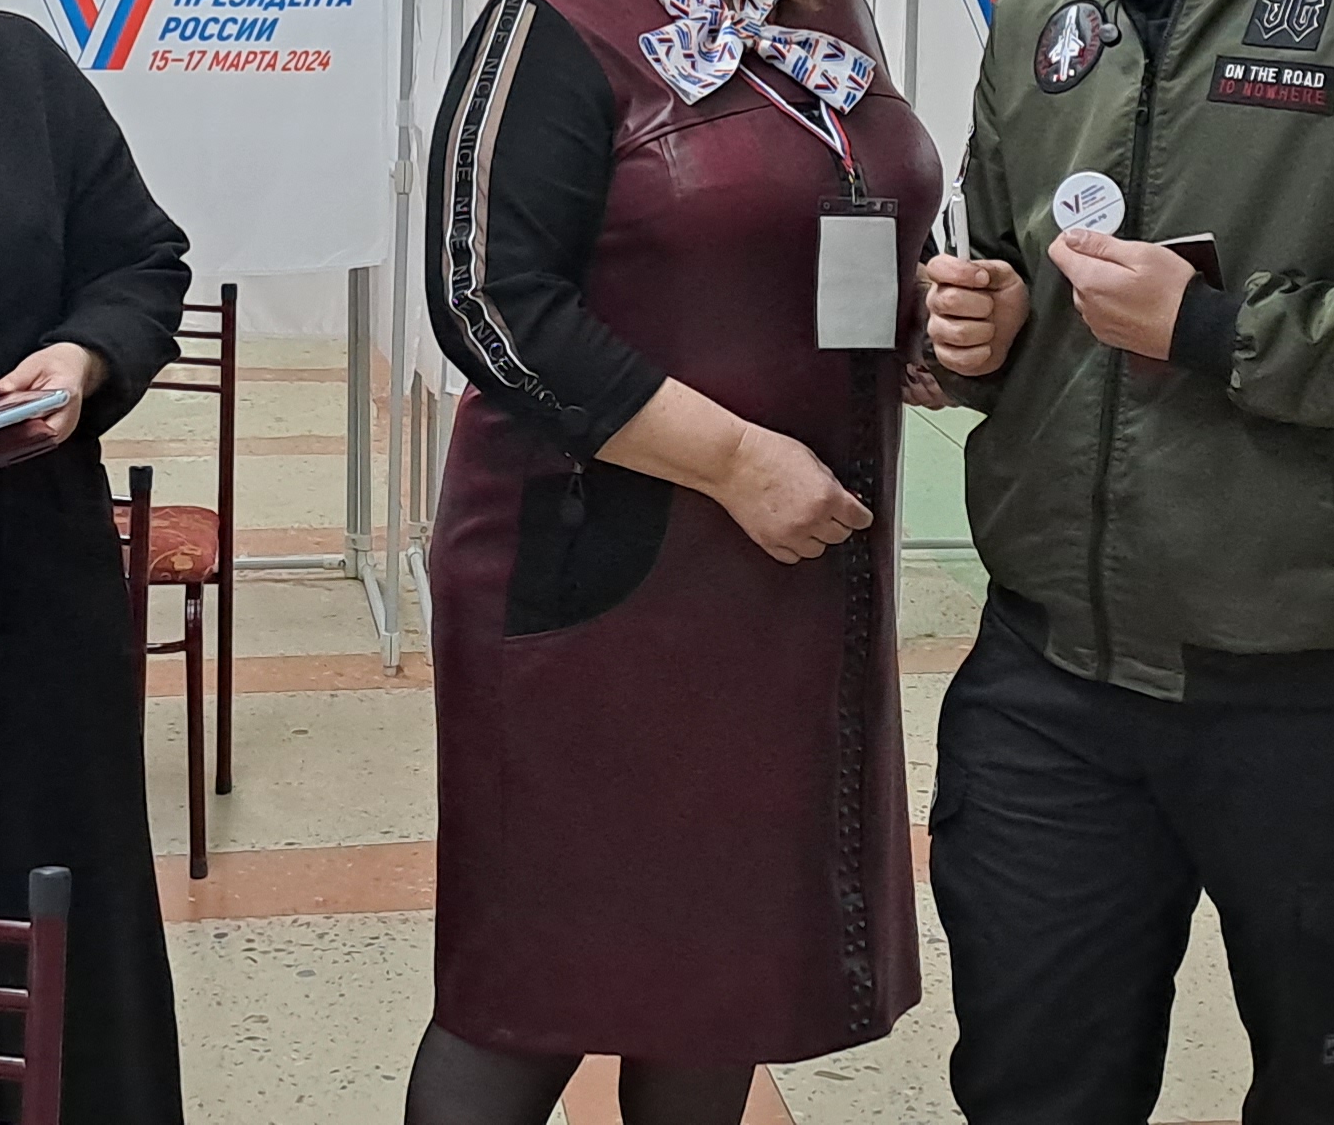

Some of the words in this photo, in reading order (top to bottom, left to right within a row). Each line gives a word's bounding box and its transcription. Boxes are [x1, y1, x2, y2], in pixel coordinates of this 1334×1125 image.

[159, 17, 279, 42] РОССИИ
[208, 50, 278, 72] МАРТА
[281, 50, 332, 72] 2024
[1224, 64, 1245, 80] ON
[1250, 66, 1278, 83] THE
[1282, 69, 1325, 88] ROAD
[1219, 80, 1235, 94] TO
[1242, 82, 1326, 105] NOWHERE
